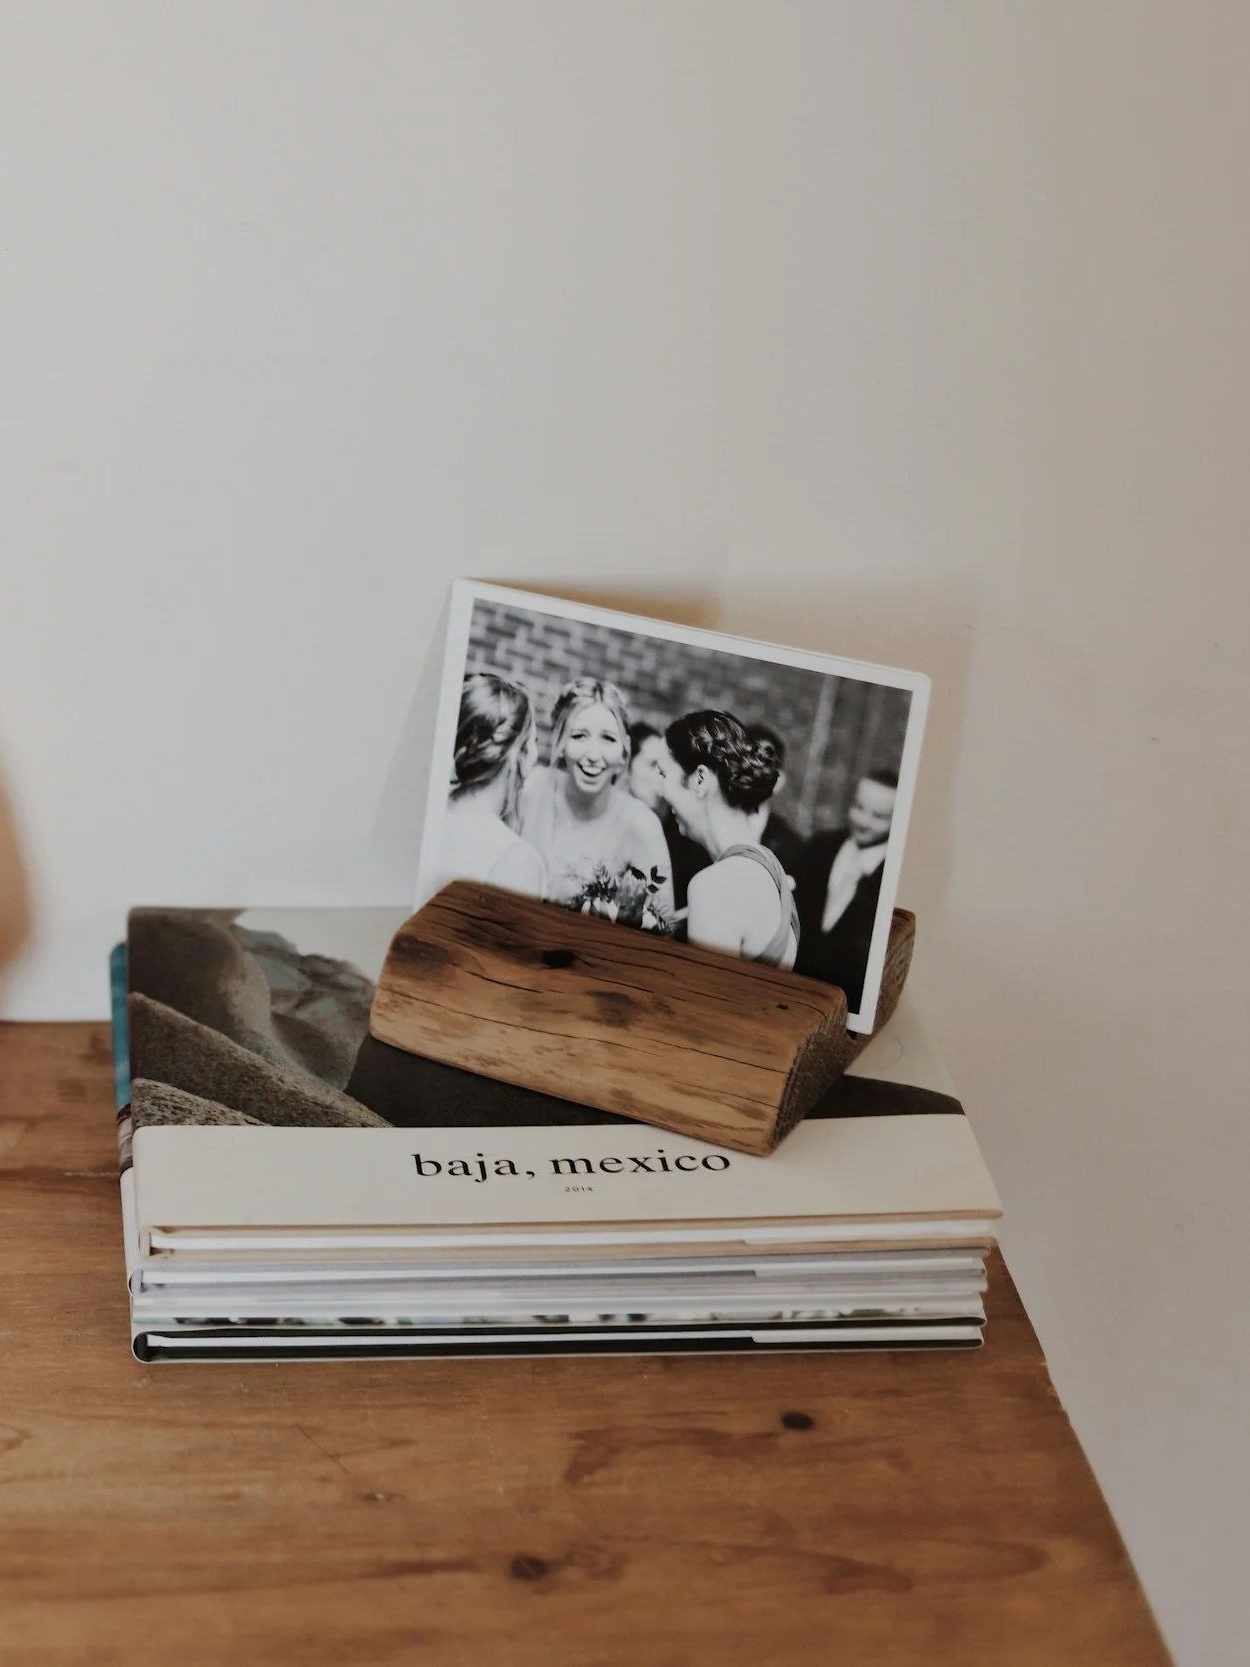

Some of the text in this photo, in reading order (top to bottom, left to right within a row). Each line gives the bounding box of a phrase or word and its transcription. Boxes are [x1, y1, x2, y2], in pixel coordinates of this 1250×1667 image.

[411, 1148, 731, 1183] baja, mexico
[564, 1185, 594, 1193] 2014
